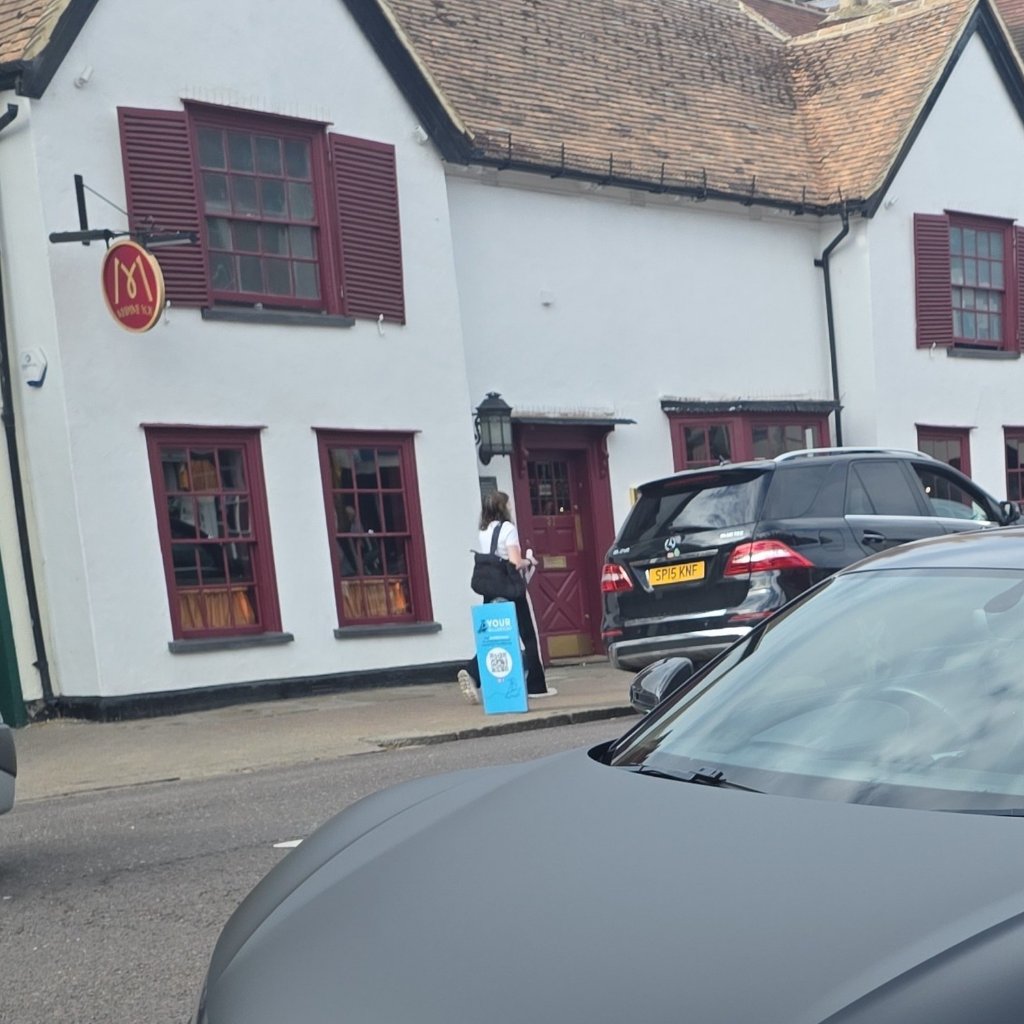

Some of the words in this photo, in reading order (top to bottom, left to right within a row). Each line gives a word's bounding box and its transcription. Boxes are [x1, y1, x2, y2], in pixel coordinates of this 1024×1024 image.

[655, 567, 677, 582] SP15
[679, 564, 699, 579] KNF
[486, 617, 512, 628] YOUR
